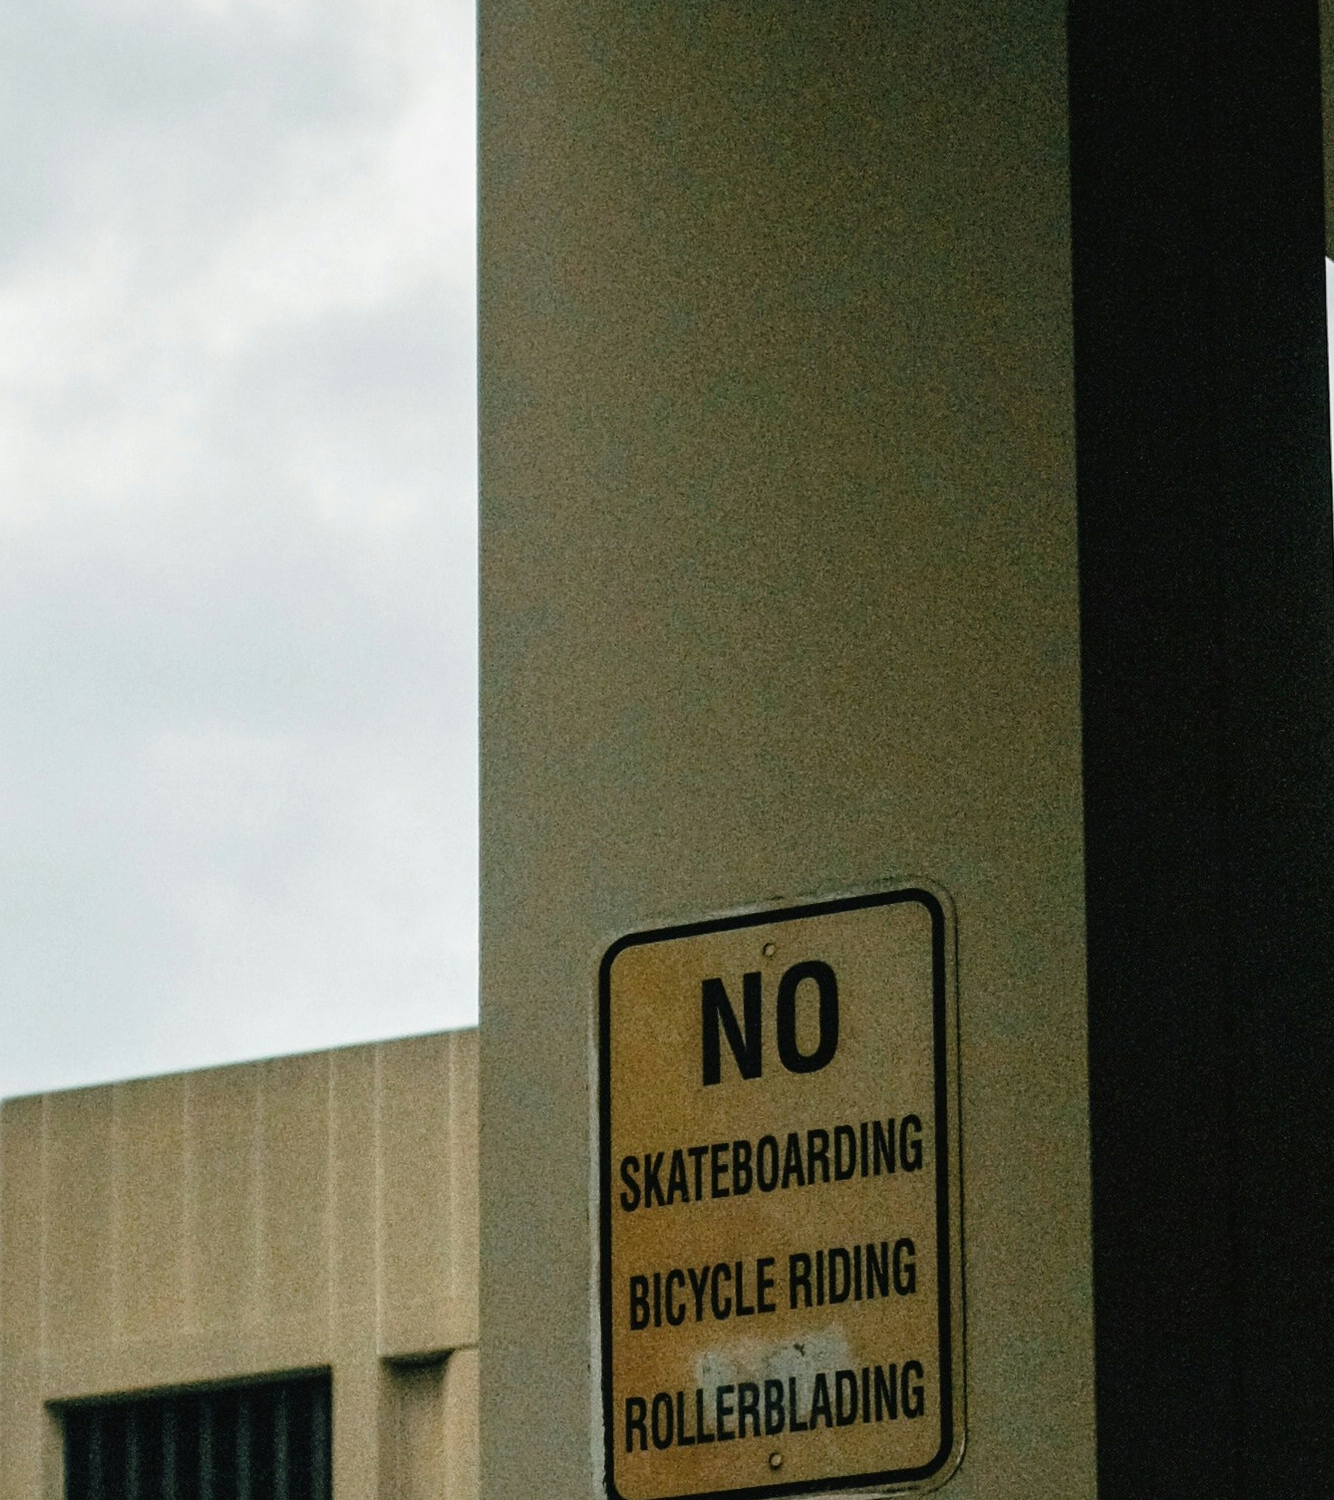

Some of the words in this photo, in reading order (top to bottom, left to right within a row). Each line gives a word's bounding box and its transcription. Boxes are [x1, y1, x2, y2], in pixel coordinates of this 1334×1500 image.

[700, 958, 839, 1086] NO
[619, 1114, 924, 1213] SKATEBOARDING
[628, 1257, 776, 1331] BICYCLE
[789, 1237, 917, 1311] RIDING
[623, 1360, 926, 1453] ROLLERBLADING
